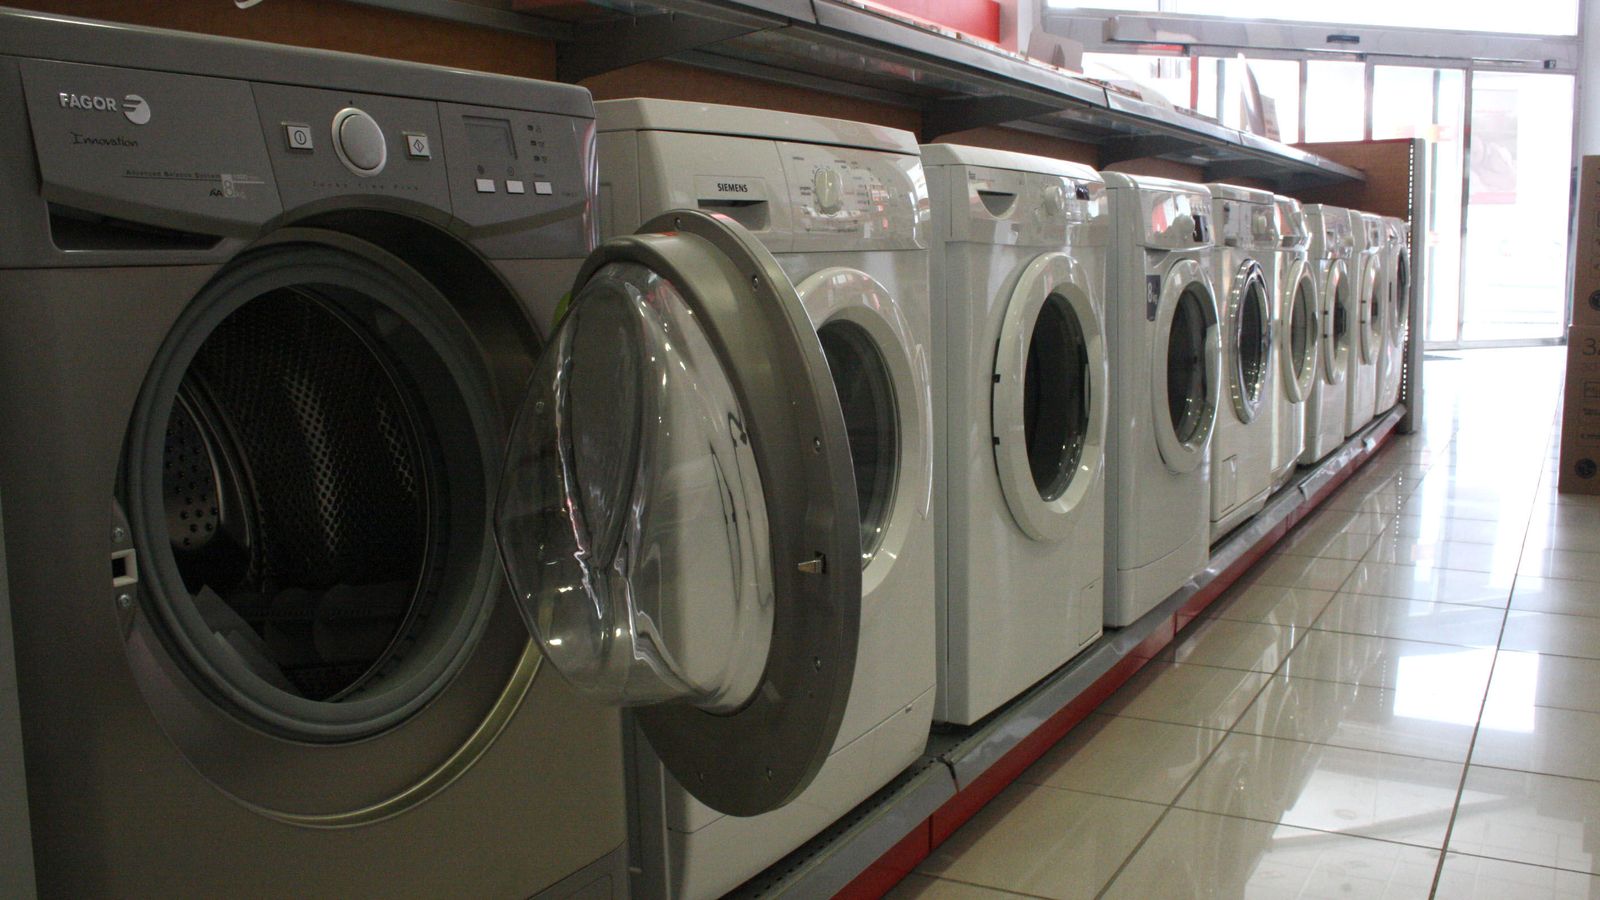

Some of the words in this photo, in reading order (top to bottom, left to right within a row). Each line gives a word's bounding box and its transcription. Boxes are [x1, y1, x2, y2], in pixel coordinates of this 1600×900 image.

[59, 92, 117, 111] FAGOR
[70, 131, 138, 147] Innovation
[717, 183, 749, 192] SIEMENS
